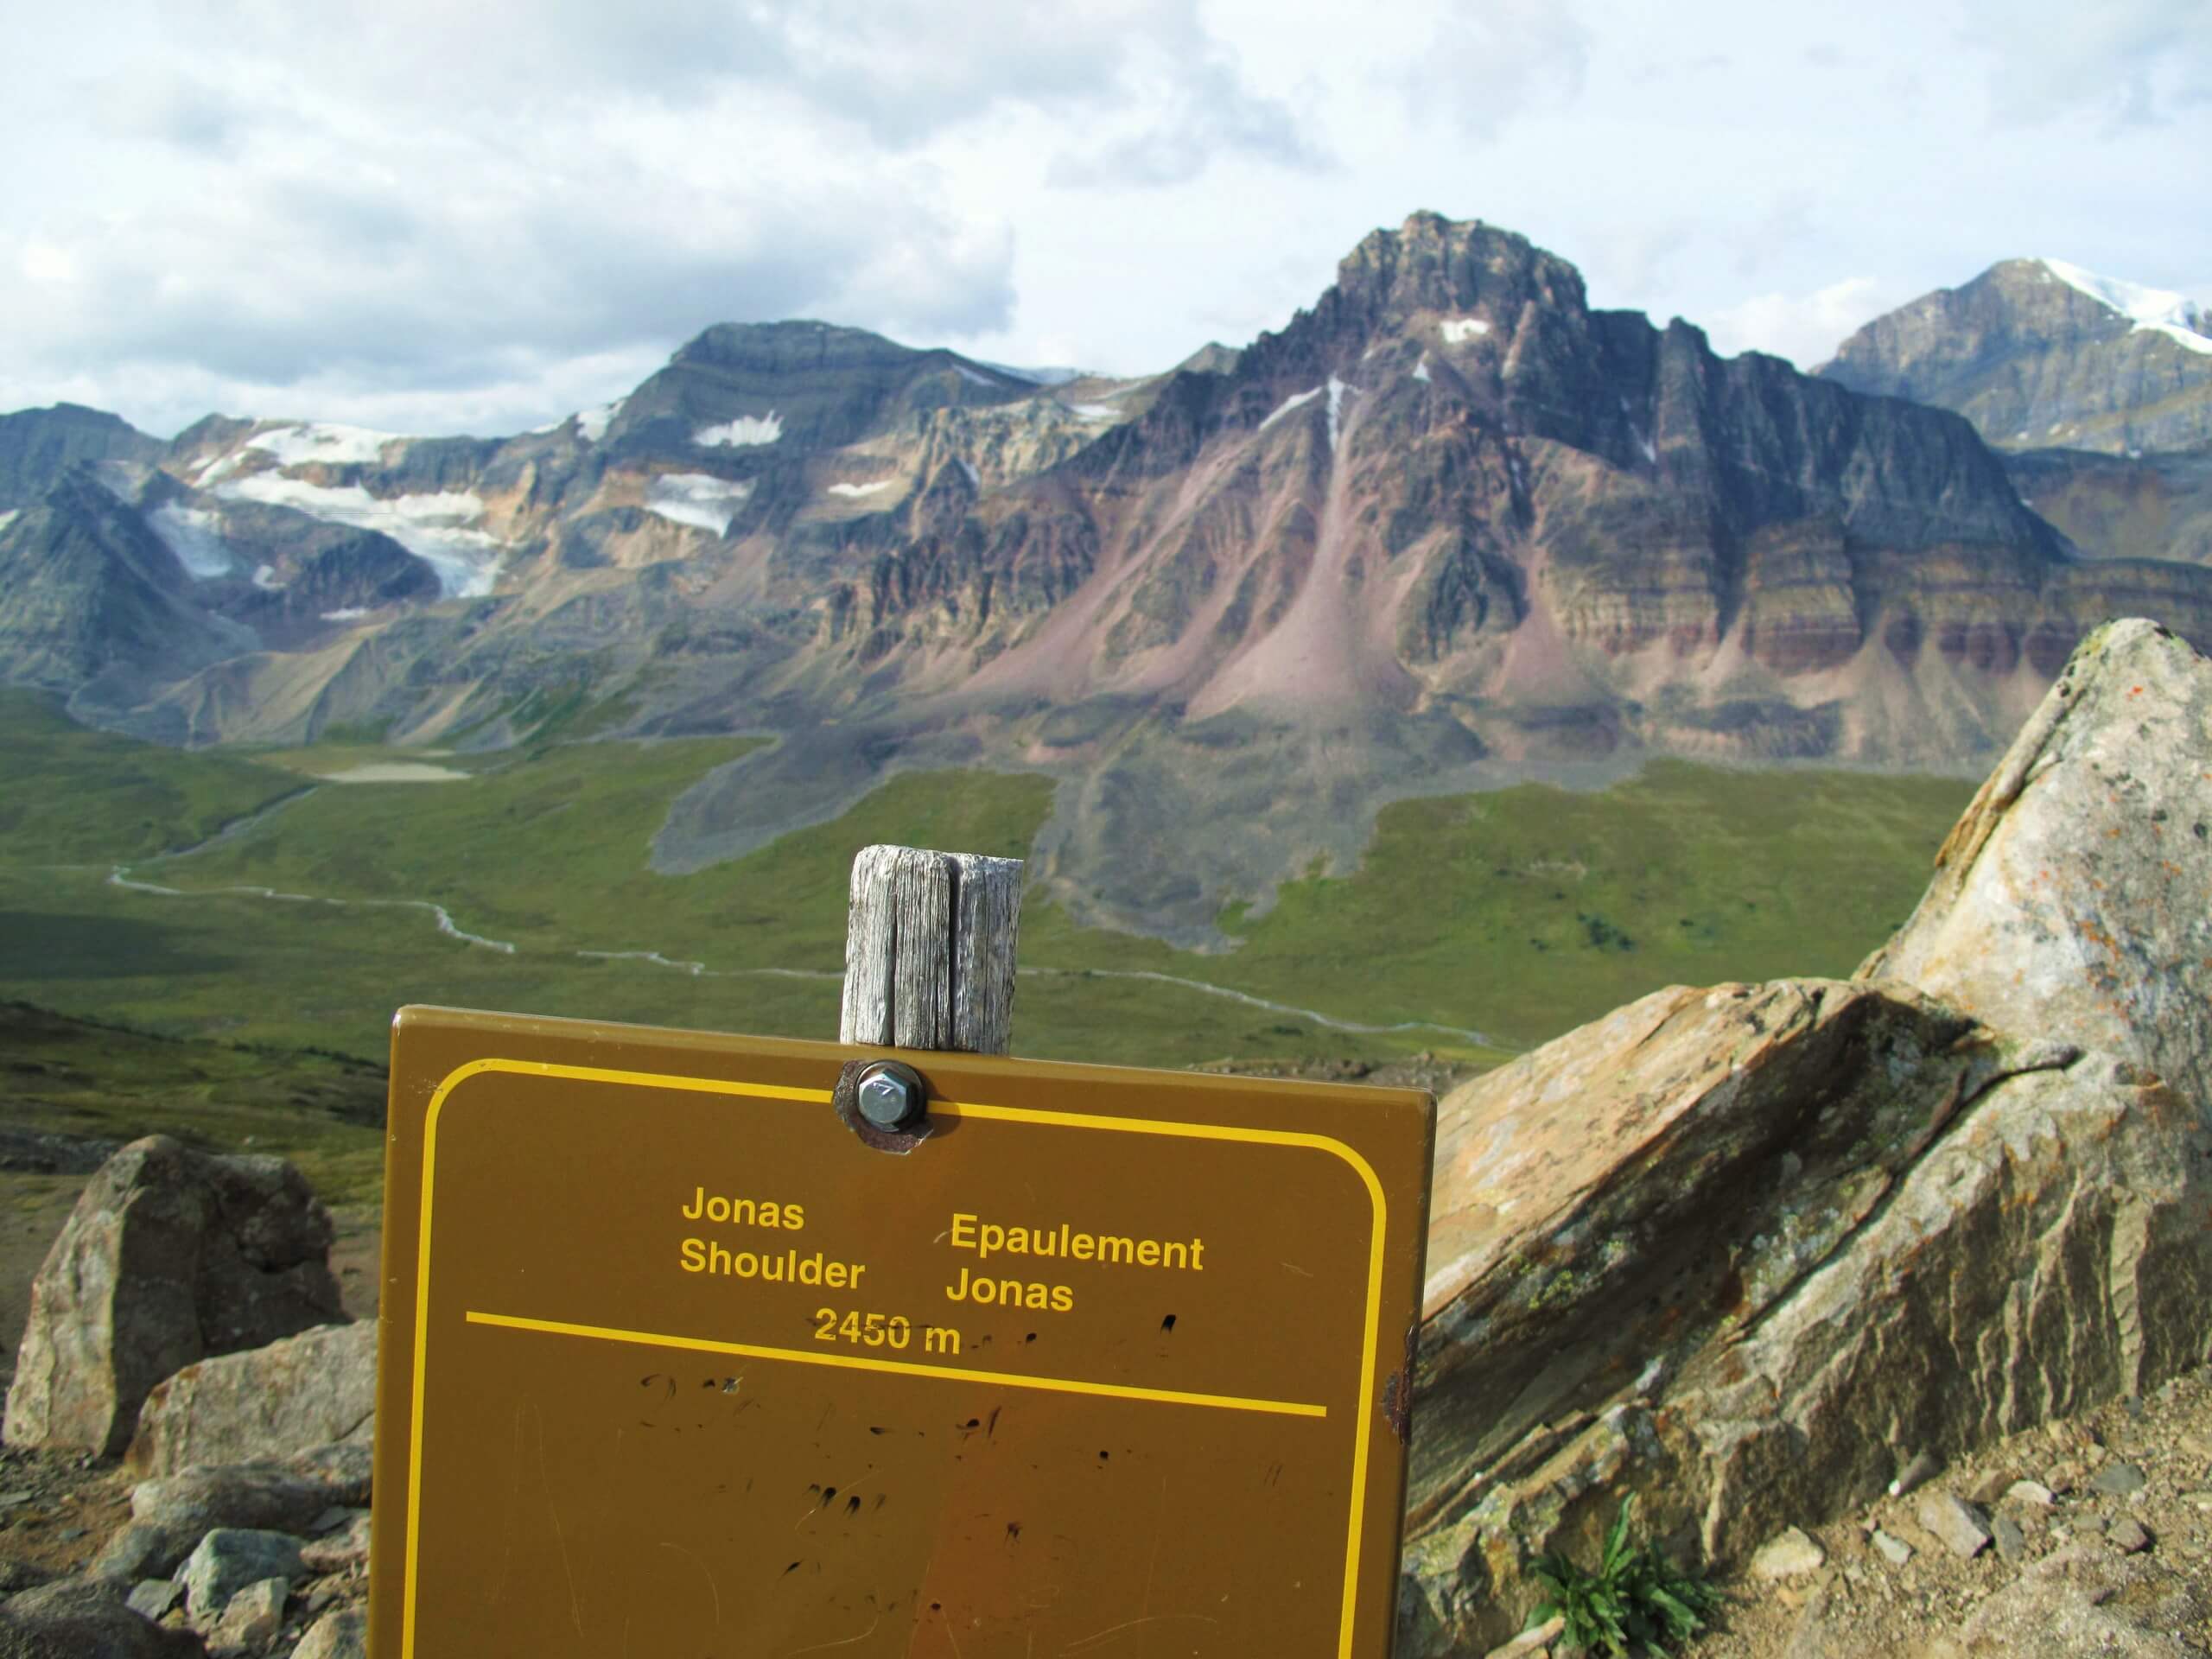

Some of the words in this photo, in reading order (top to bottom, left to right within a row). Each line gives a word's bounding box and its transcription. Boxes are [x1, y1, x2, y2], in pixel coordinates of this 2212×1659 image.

[683, 1187, 804, 1230] Jonas
[681, 1238, 866, 1289] Shoulder
[951, 1214, 1205, 1270] Epaulement
[947, 1268, 1073, 1312] Jonas
[815, 1308, 911, 1349] 2450
[925, 1325, 961, 1355] m
